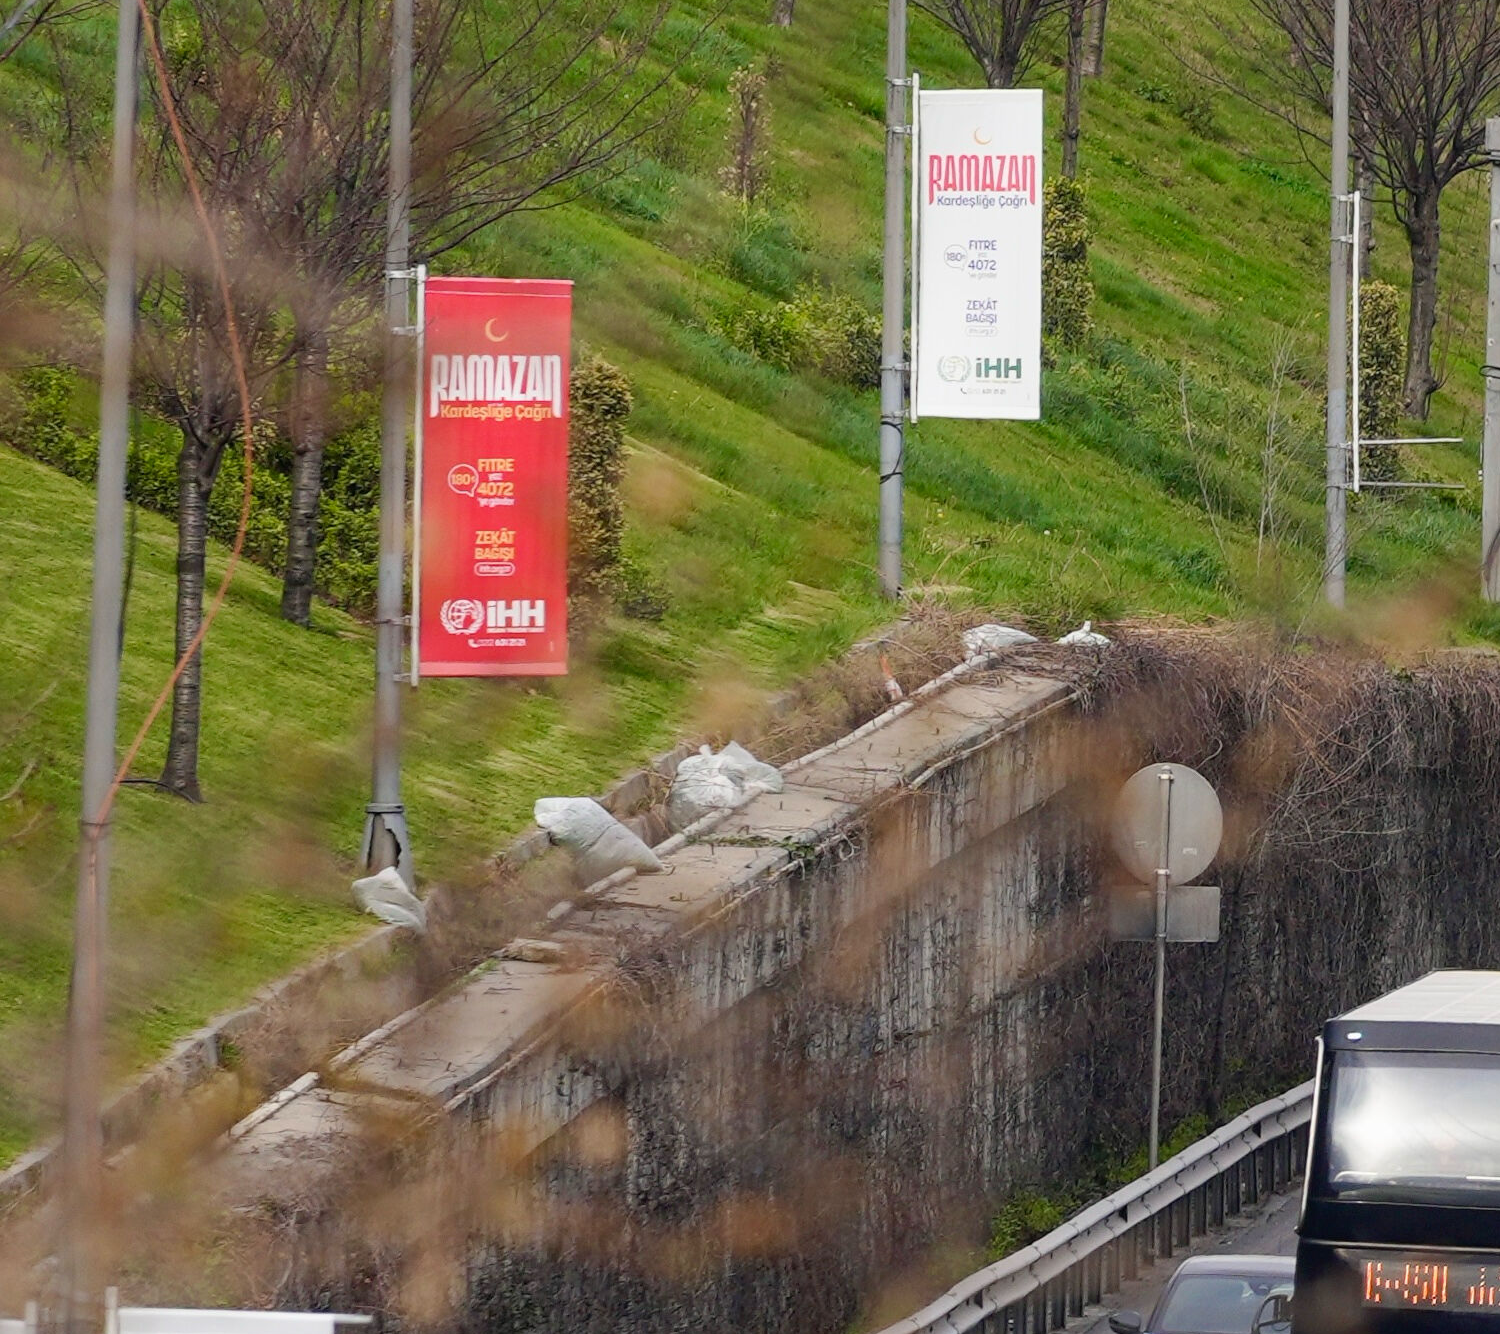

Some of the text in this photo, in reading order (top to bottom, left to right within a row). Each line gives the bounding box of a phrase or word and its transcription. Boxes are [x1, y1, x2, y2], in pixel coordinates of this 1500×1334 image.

[928, 154, 1036, 206] RAMAZAN
[936, 194, 1028, 210] Kardeşliğe Çağrı
[967, 259, 997, 271] 4072
[965, 311, 998, 325] BAĞIŞI
[430, 354, 562, 418] RAMAZAN
[440, 402, 552, 422] Kardeşliğe Çağrı
[477, 482, 514, 496] 4072
